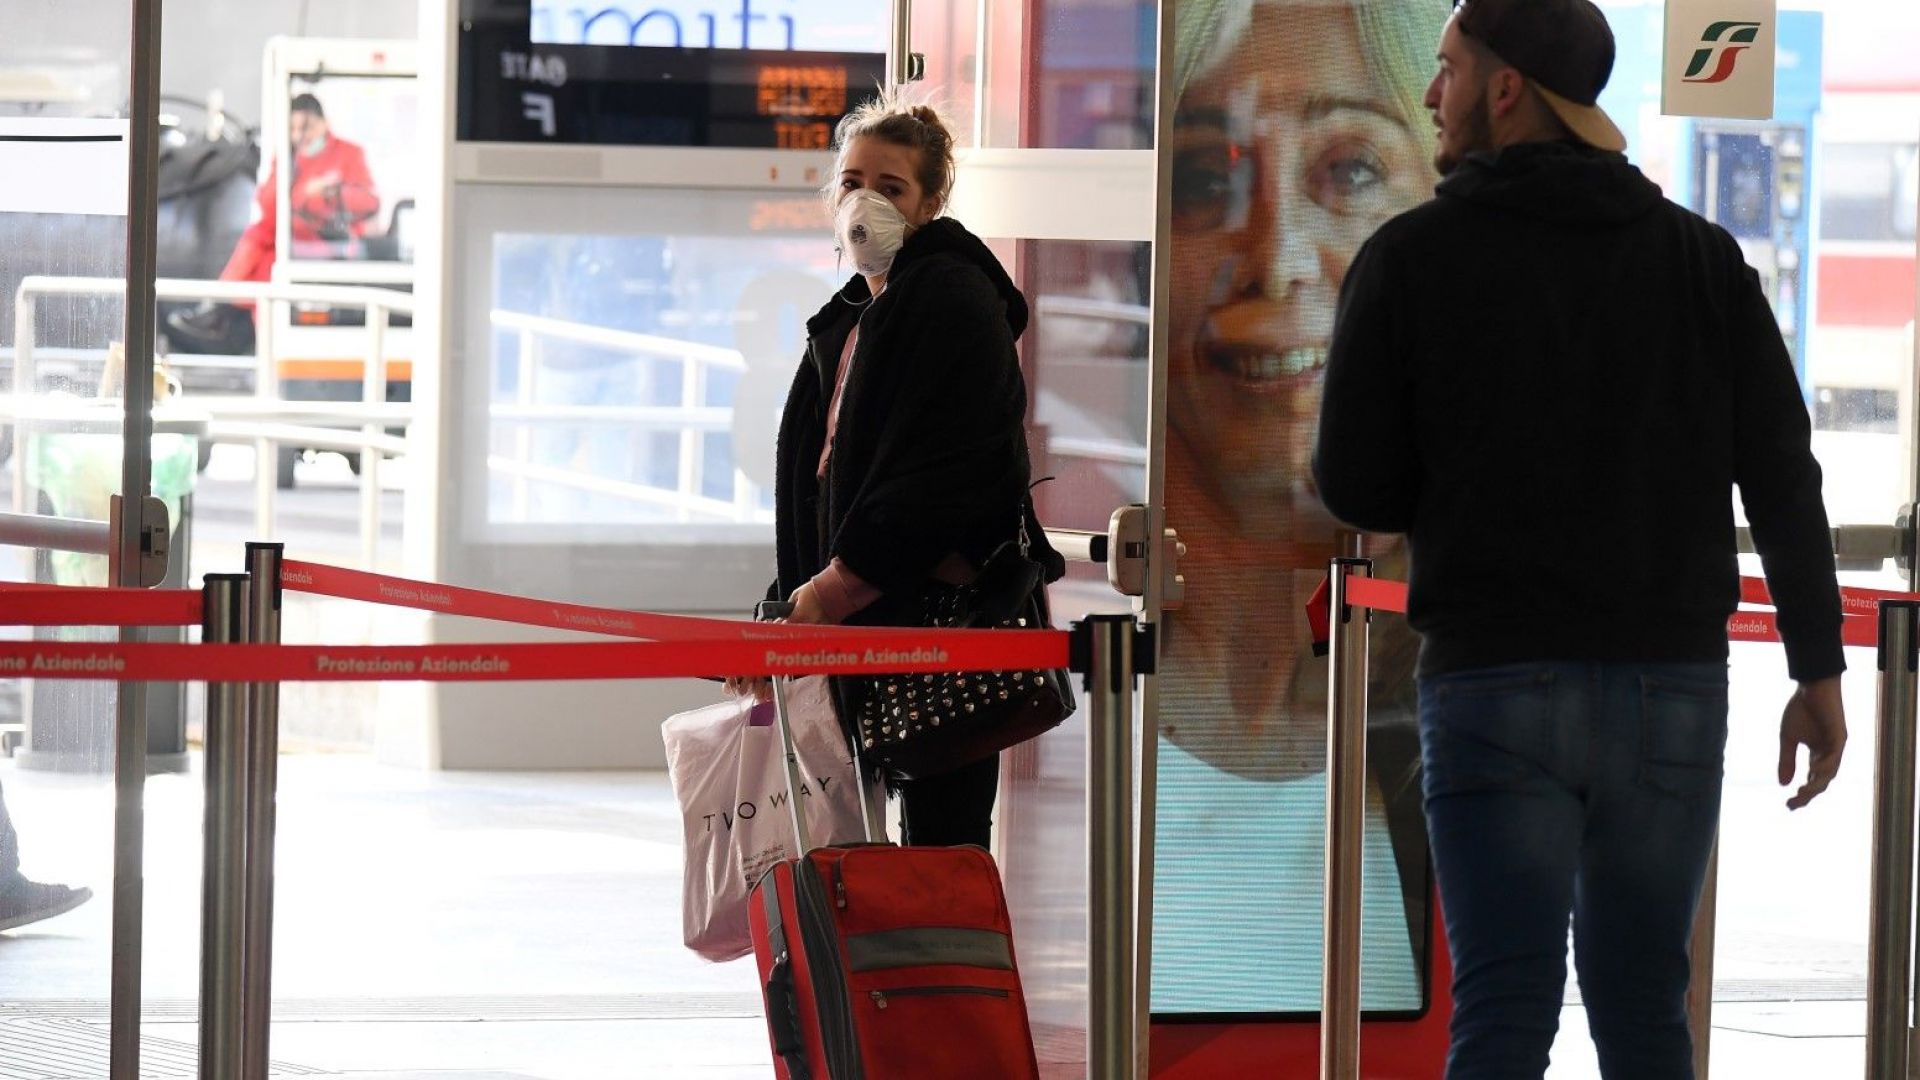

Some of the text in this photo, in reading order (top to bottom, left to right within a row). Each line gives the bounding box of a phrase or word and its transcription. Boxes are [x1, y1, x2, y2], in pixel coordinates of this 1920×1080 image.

[32, 653, 125, 671] Aziendale
[317, 655, 509, 672] Protezione Aziendale
[765, 647, 948, 667] Protezione Aziendale
[769, 776, 831, 808] WAY
